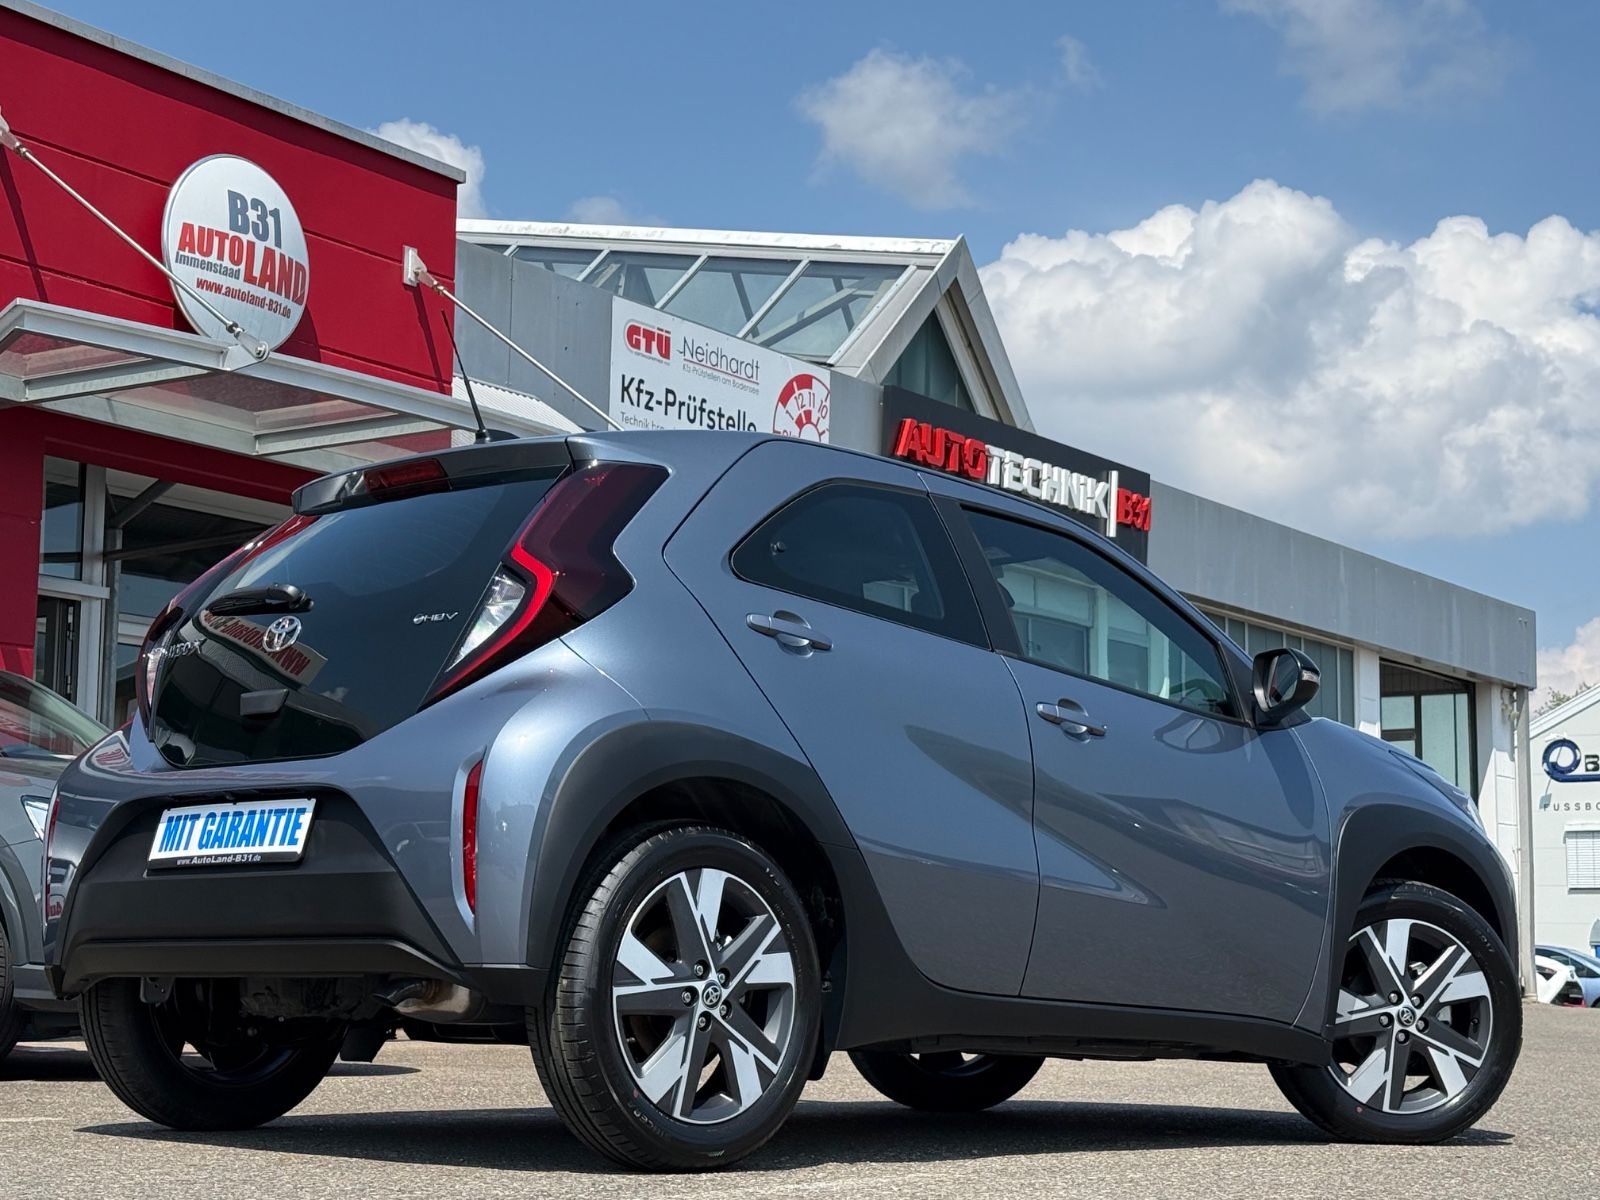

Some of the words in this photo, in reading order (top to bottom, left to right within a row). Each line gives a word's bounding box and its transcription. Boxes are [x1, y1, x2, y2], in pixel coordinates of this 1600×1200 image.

[228, 189, 282, 249] B31
[175, 251, 241, 281] Immenstaad
[177, 222, 307, 306] AUTOLAND
[196, 277, 291, 319] www.autoland-B31.de
[625, 323, 672, 361] GTÜ
[682, 335, 760, 382] Neidhardt
[620, 411, 650, 427] Technik
[1116, 487, 1152, 532] B31
[158, 813, 201, 853] MIT
[198, 807, 308, 850] GARANTIE
